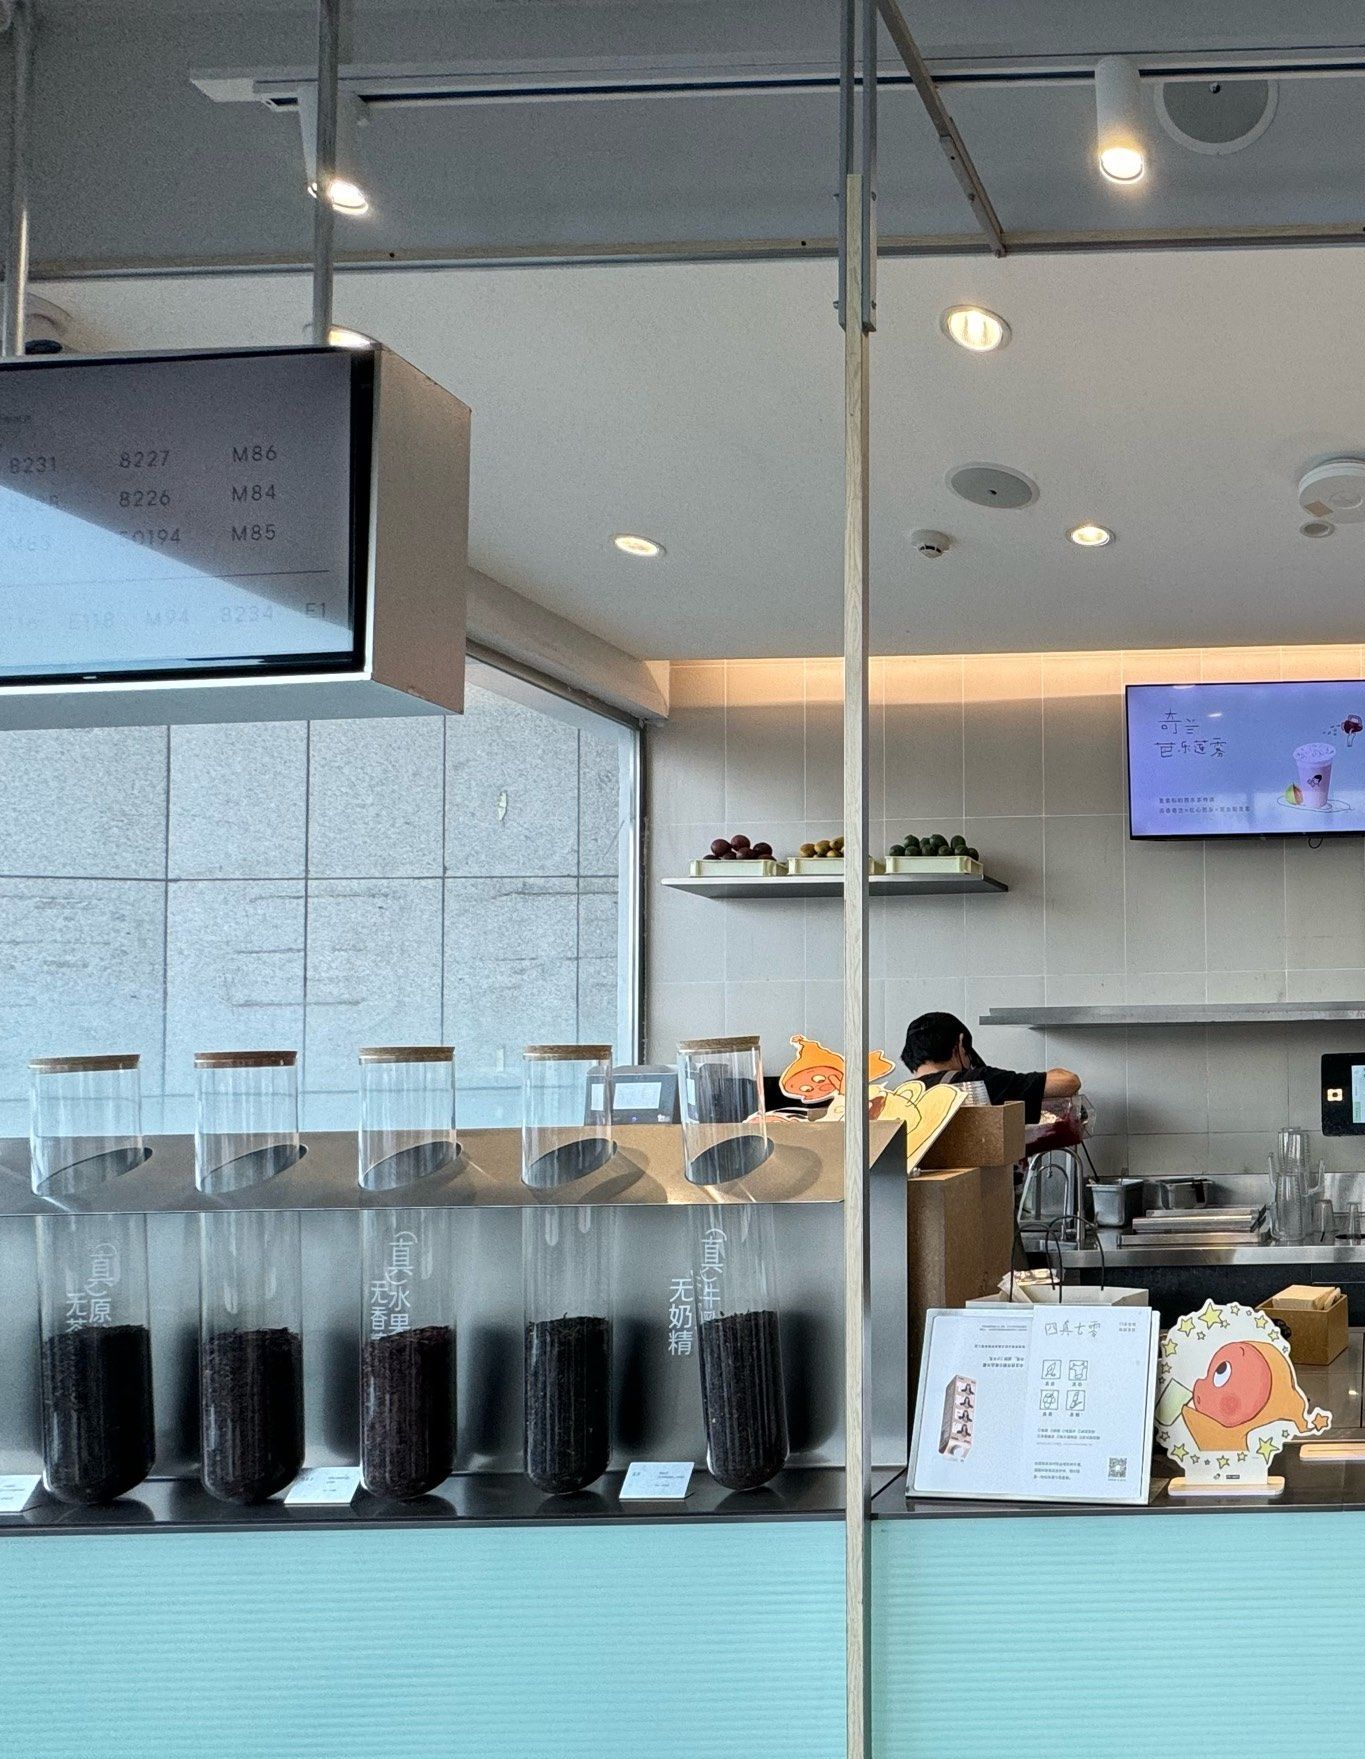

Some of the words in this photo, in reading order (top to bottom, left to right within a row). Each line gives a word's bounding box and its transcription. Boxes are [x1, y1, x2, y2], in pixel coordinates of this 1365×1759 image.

[118, 450, 170, 469] 8227
[232, 445, 278, 462] M86
[9, 456, 57, 474] 8231
[118, 490, 171, 508] 8226
[231, 484, 277, 502] M84
[231, 524, 276, 541] M85
[1158, 708, 1200, 734] 奇兰
[668, 1278, 694, 1356] 无奶精
